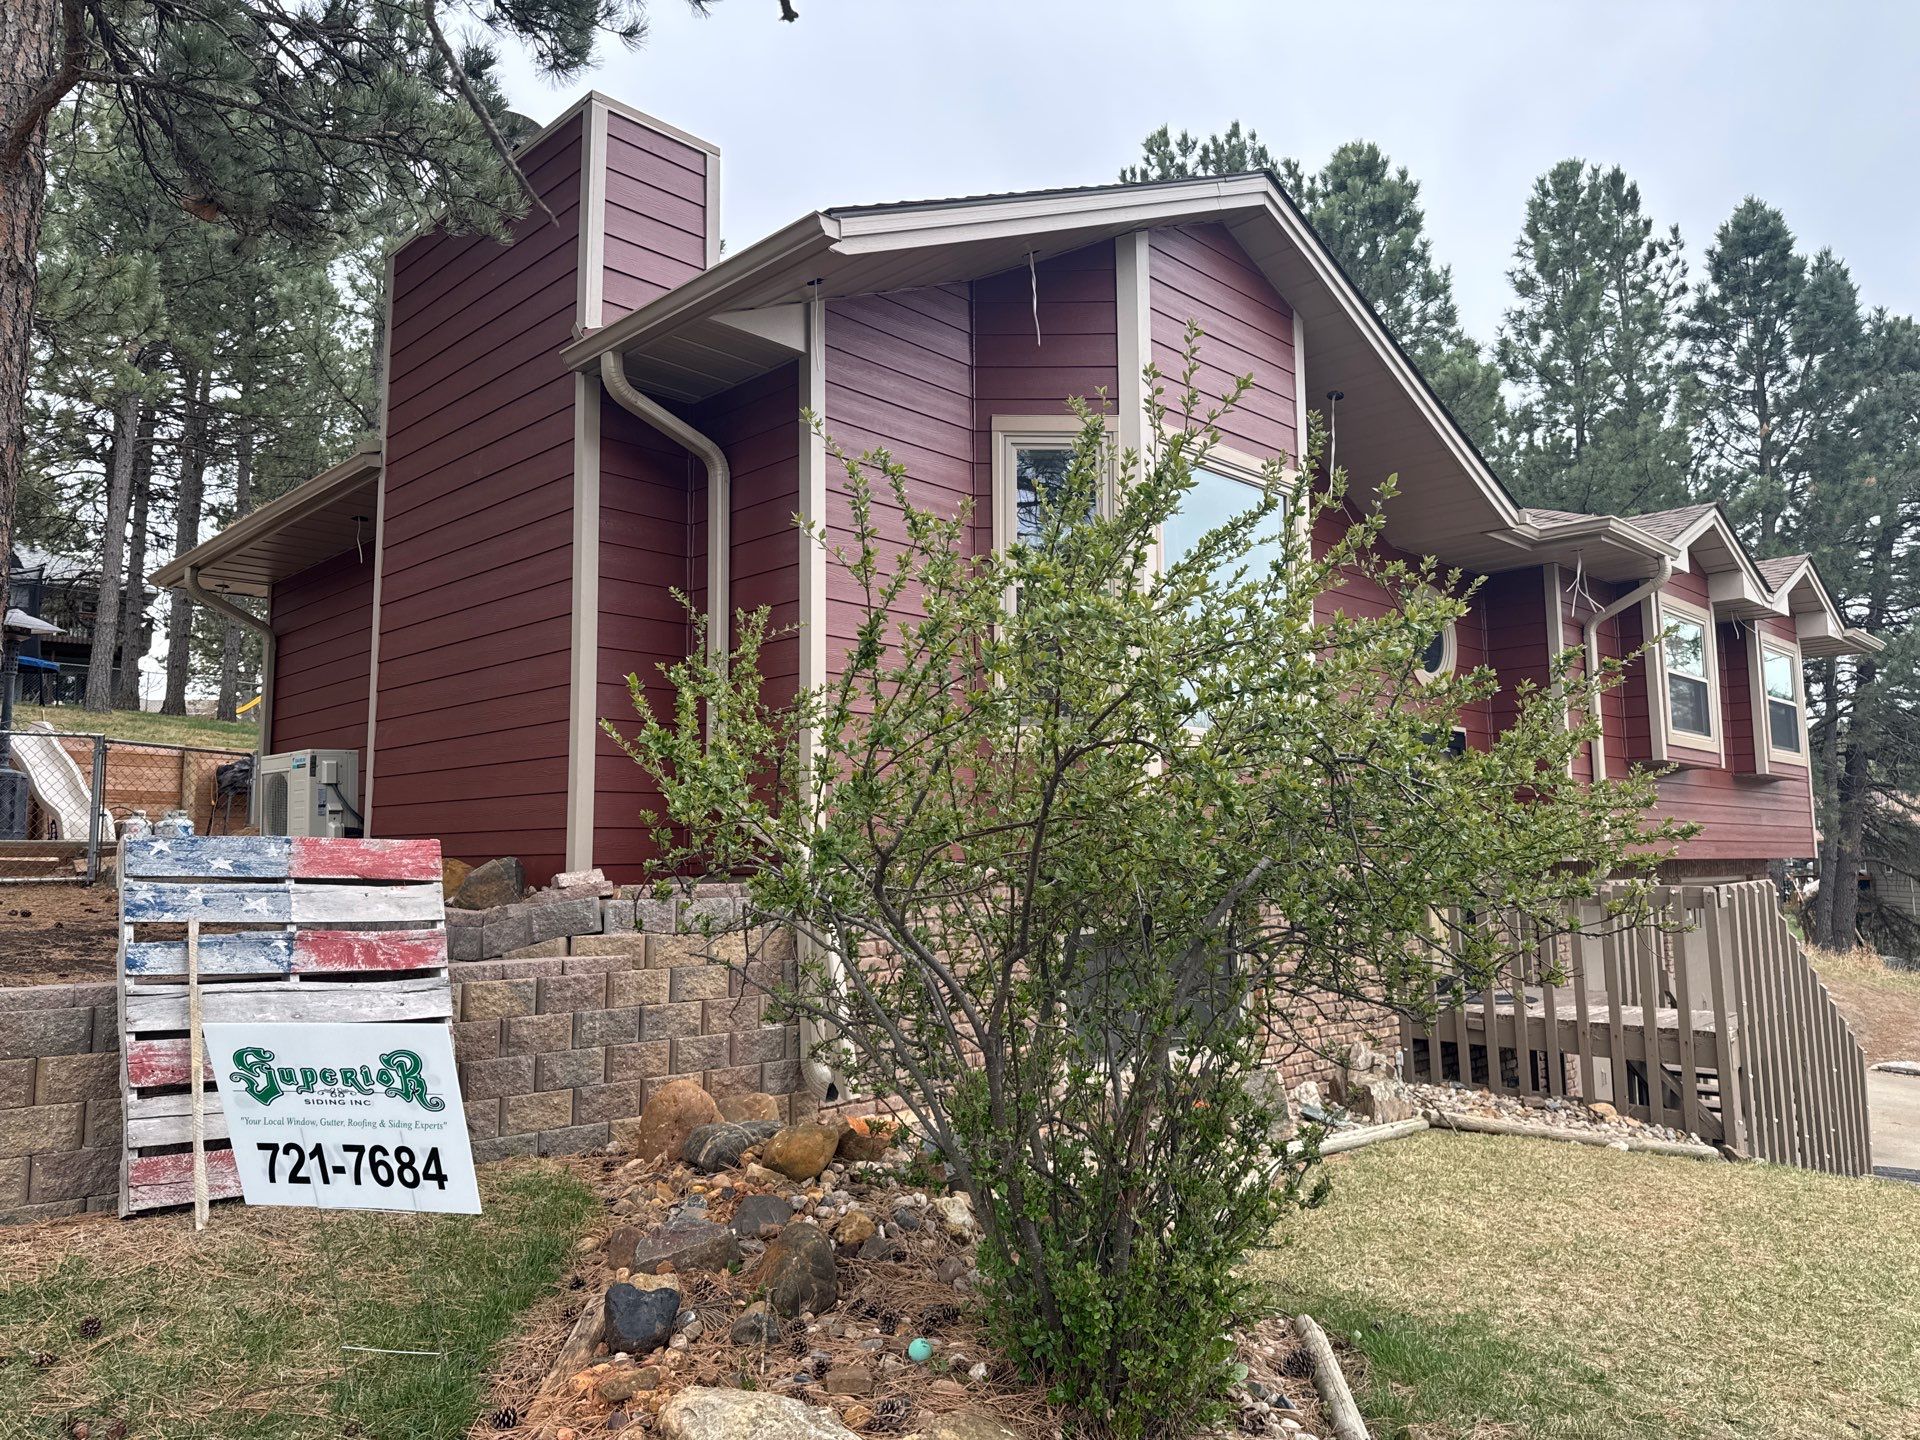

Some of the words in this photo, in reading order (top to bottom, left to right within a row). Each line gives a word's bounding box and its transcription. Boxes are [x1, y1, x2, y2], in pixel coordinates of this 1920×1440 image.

[304, 1098, 346, 1106] SIDING
[240, 1116, 261, 1126] "Your
[263, 1116, 285, 1126] Local
[286, 1117, 318, 1127] Window,
[319, 1117, 346, 1127] Gutter,
[347, 1118, 377, 1129] Roofing
[378, 1119, 386, 1128] &
[388, 1120, 413, 1130] Siding
[414, 1120, 448, 1131] Experts"
[256, 1142, 448, 1190] 721-7684
